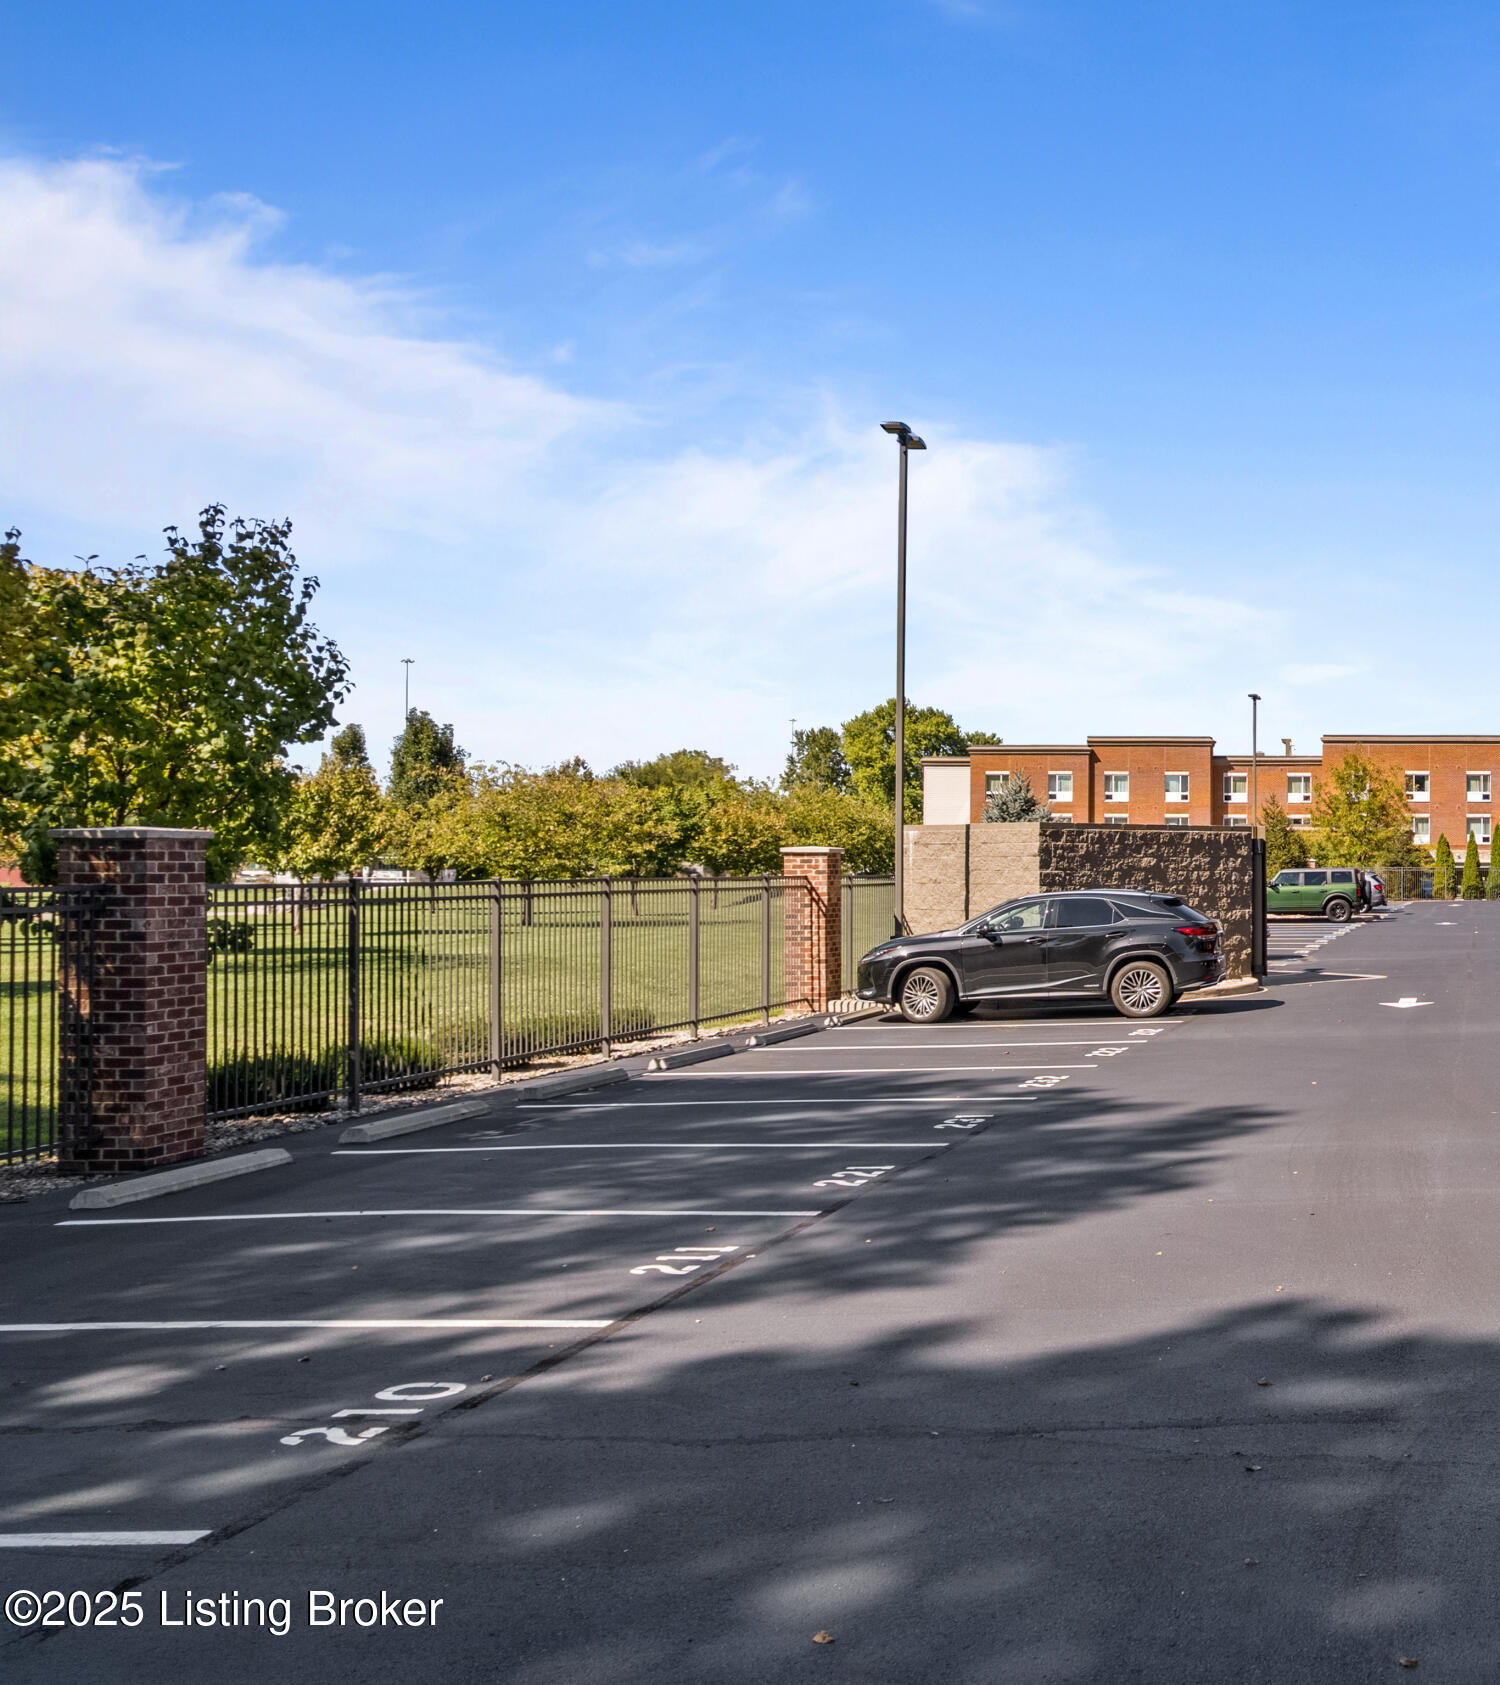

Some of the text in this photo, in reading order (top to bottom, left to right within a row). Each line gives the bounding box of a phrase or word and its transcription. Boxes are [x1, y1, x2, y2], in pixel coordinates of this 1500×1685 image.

[933, 1114, 994, 1129] 231
[812, 1165, 895, 1187] 221
[629, 1245, 740, 1276] 211
[280, 1381, 468, 1446] 210
